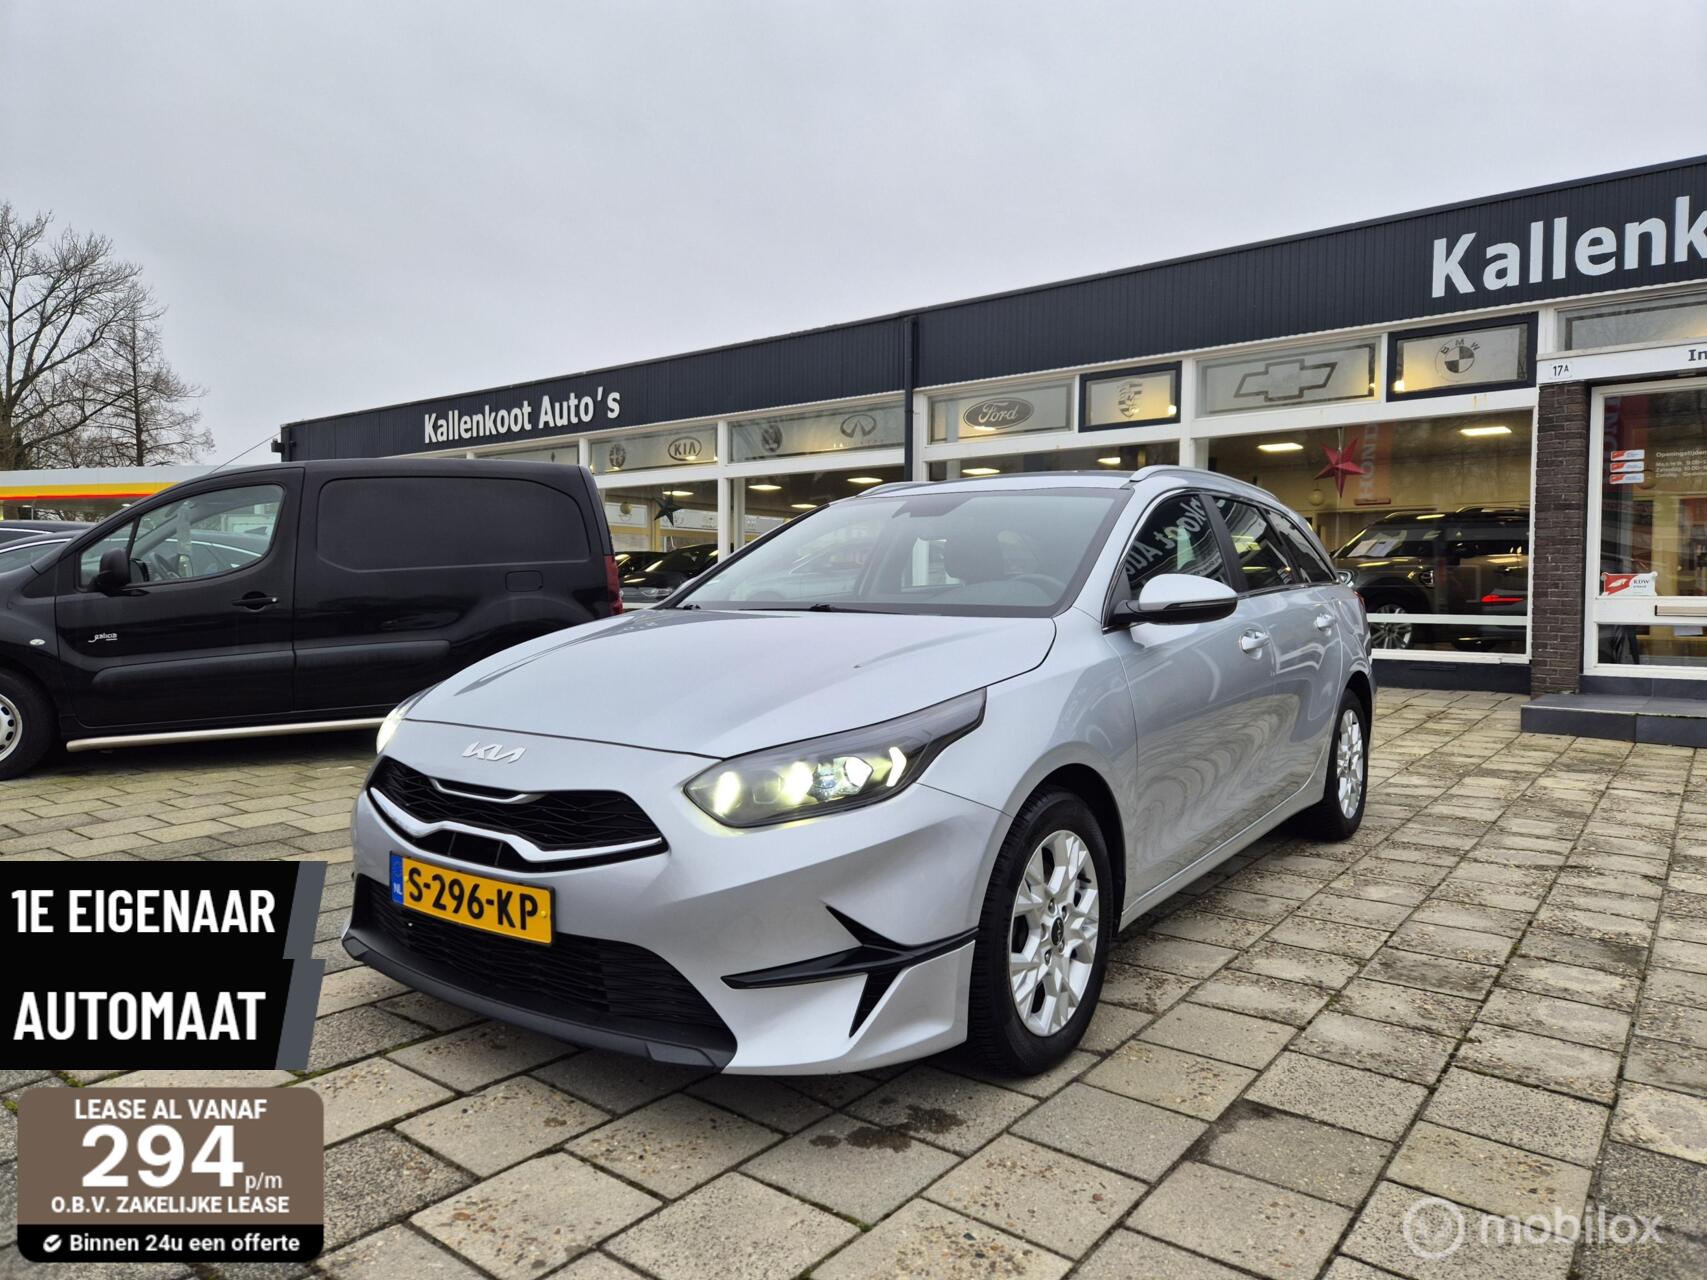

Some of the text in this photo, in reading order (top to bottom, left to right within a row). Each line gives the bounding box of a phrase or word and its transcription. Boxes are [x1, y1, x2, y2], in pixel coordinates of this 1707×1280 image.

[1431, 195, 1707, 298] Kallenk
[424, 386, 621, 444] Kallenkoot Auto's
[978, 401, 1020, 424] Ford
[673, 440, 697, 456] KIA
[408, 866, 538, 931] S-296-KP
